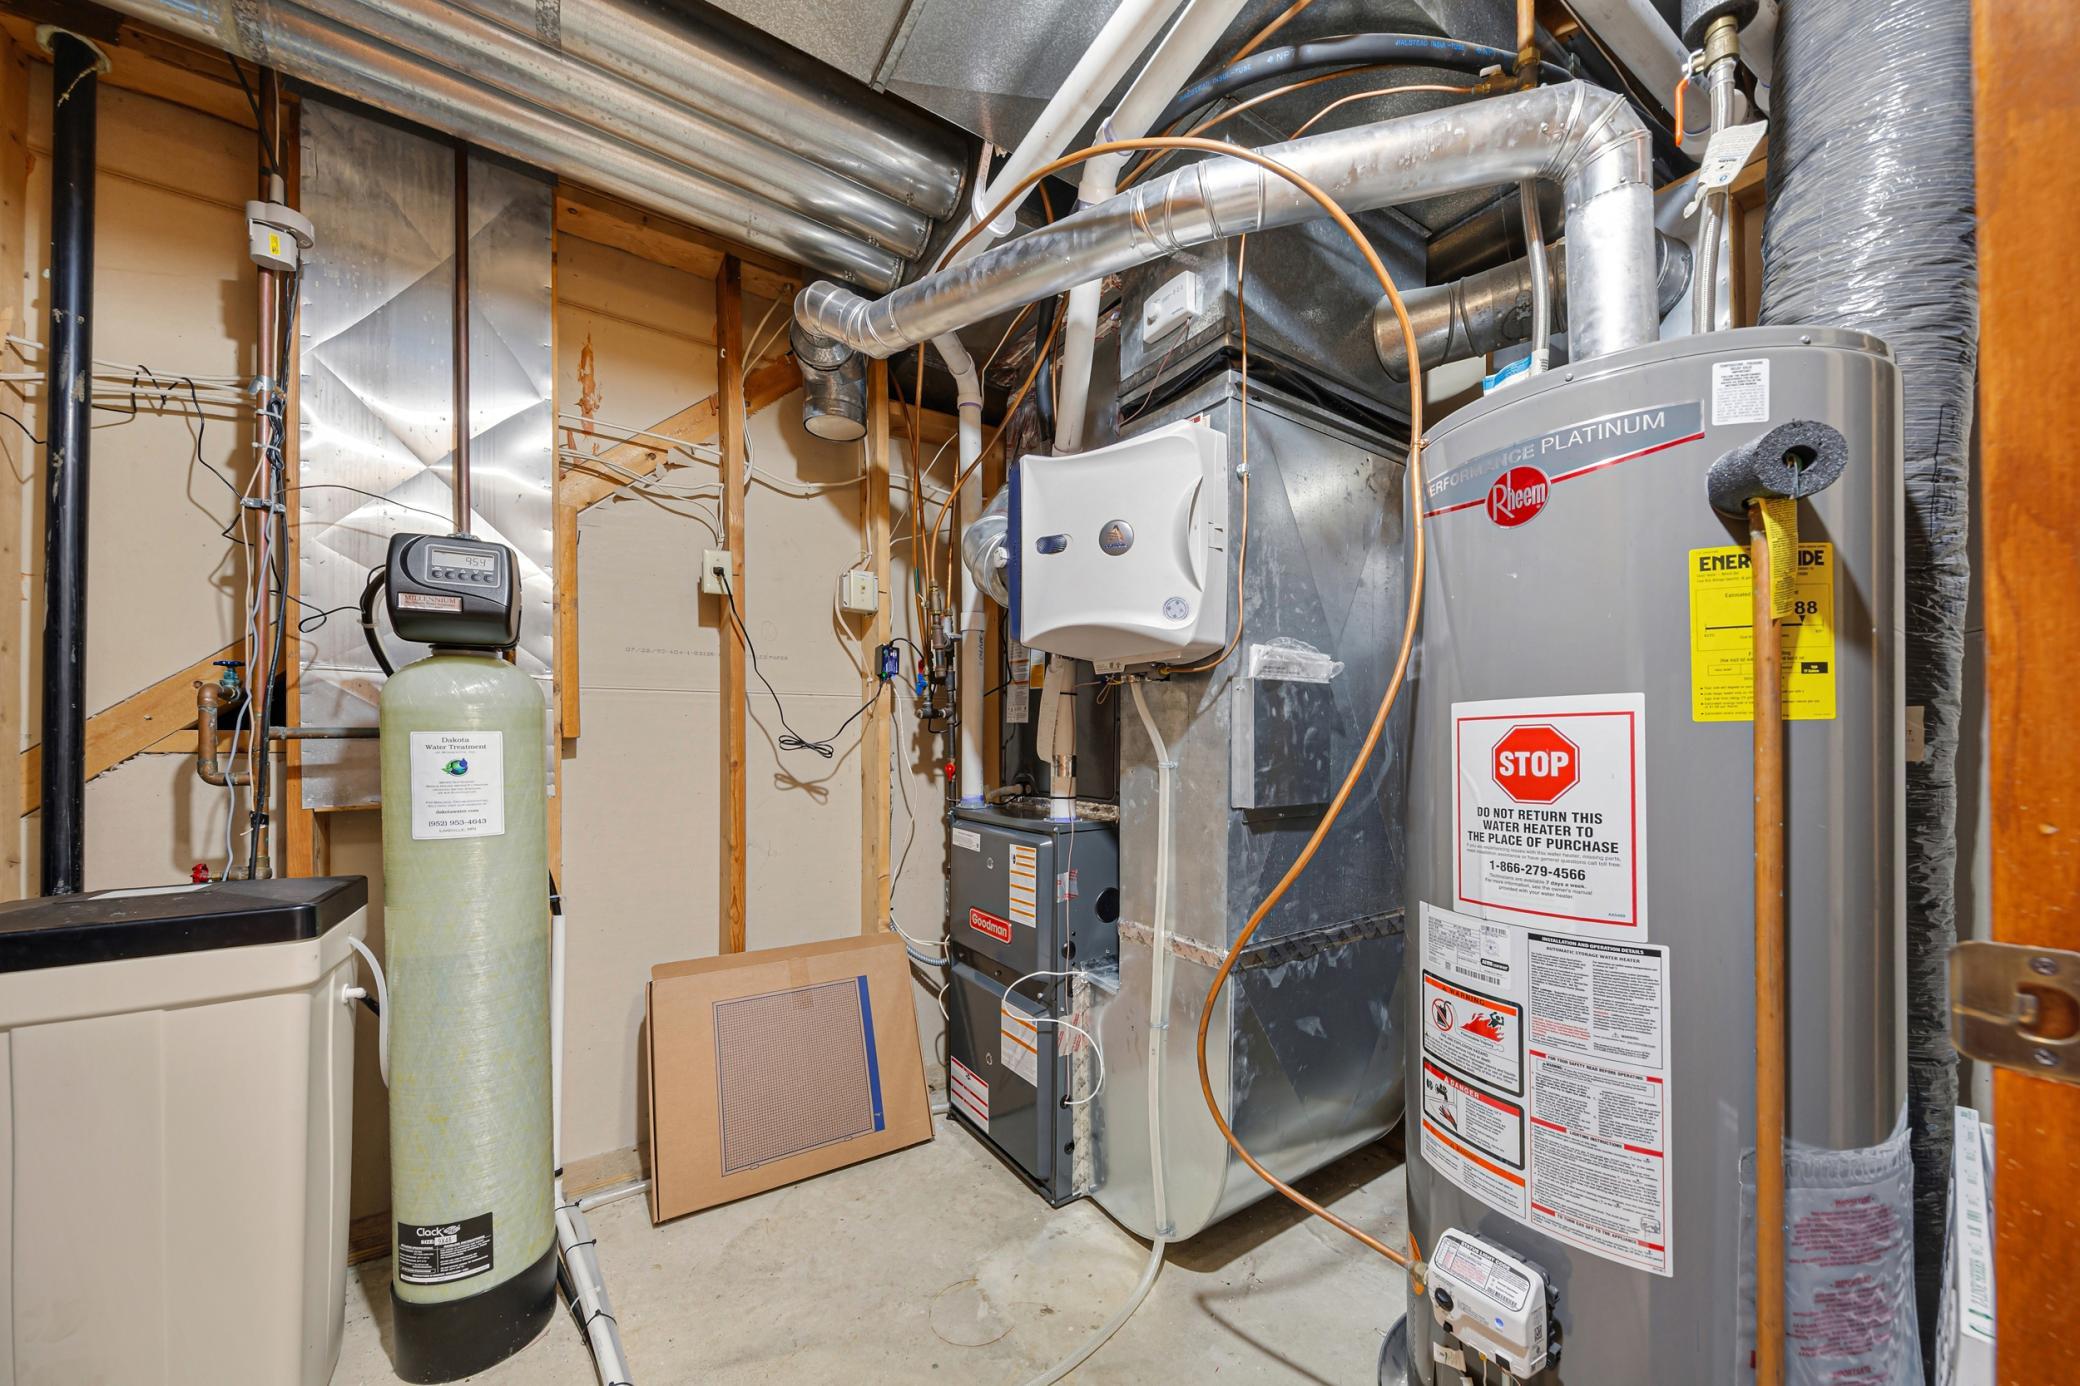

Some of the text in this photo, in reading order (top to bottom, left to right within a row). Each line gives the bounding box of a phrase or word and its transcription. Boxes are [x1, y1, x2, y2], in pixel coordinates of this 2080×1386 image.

[1428, 411, 1665, 498] ERFORMANCE PLATINUM
[1492, 470, 1546, 522] Rheem
[1499, 751, 1569, 777] STOP
[449, 818, 487, 826] 953-4643
[1477, 806, 1603, 825] DO NOT RETURN THIS
[1483, 820, 1593, 838] WATER HEATER TO
[1467, 830, 1620, 854] THE PLACE OF PURCHASE
[1489, 860, 1586, 881] 1-866-279-4566
[972, 914, 1007, 938] Goodman
[1542, 936, 1644, 955] INSTALLATION AND OPERATION DETAILS
[1546, 946, 1574, 954] AUTOMATIC
[1576, 949, 1598, 958] STORAGE
[1450, 988, 1484, 1005] WARNING
[1569, 1060, 1585, 1069] SAFETY
[1586, 1064, 1598, 1072] READ
[1599, 1068, 1616, 1076] BEFORE
[1617, 1071, 1643, 1080] OPERATING
[1450, 1080, 1480, 1099] DANGER
[1569, 1131, 1622, 1148] LIGHTING INSTRUCTIONS
[416, 1227, 444, 1238] Clack
[1564, 1216, 1575, 1224] TURN
[1576, 1220, 1584, 1228] GAS
[1602, 1229, 1610, 1237] THE
[1611, 1233, 1637, 1244] APPLIANCE
